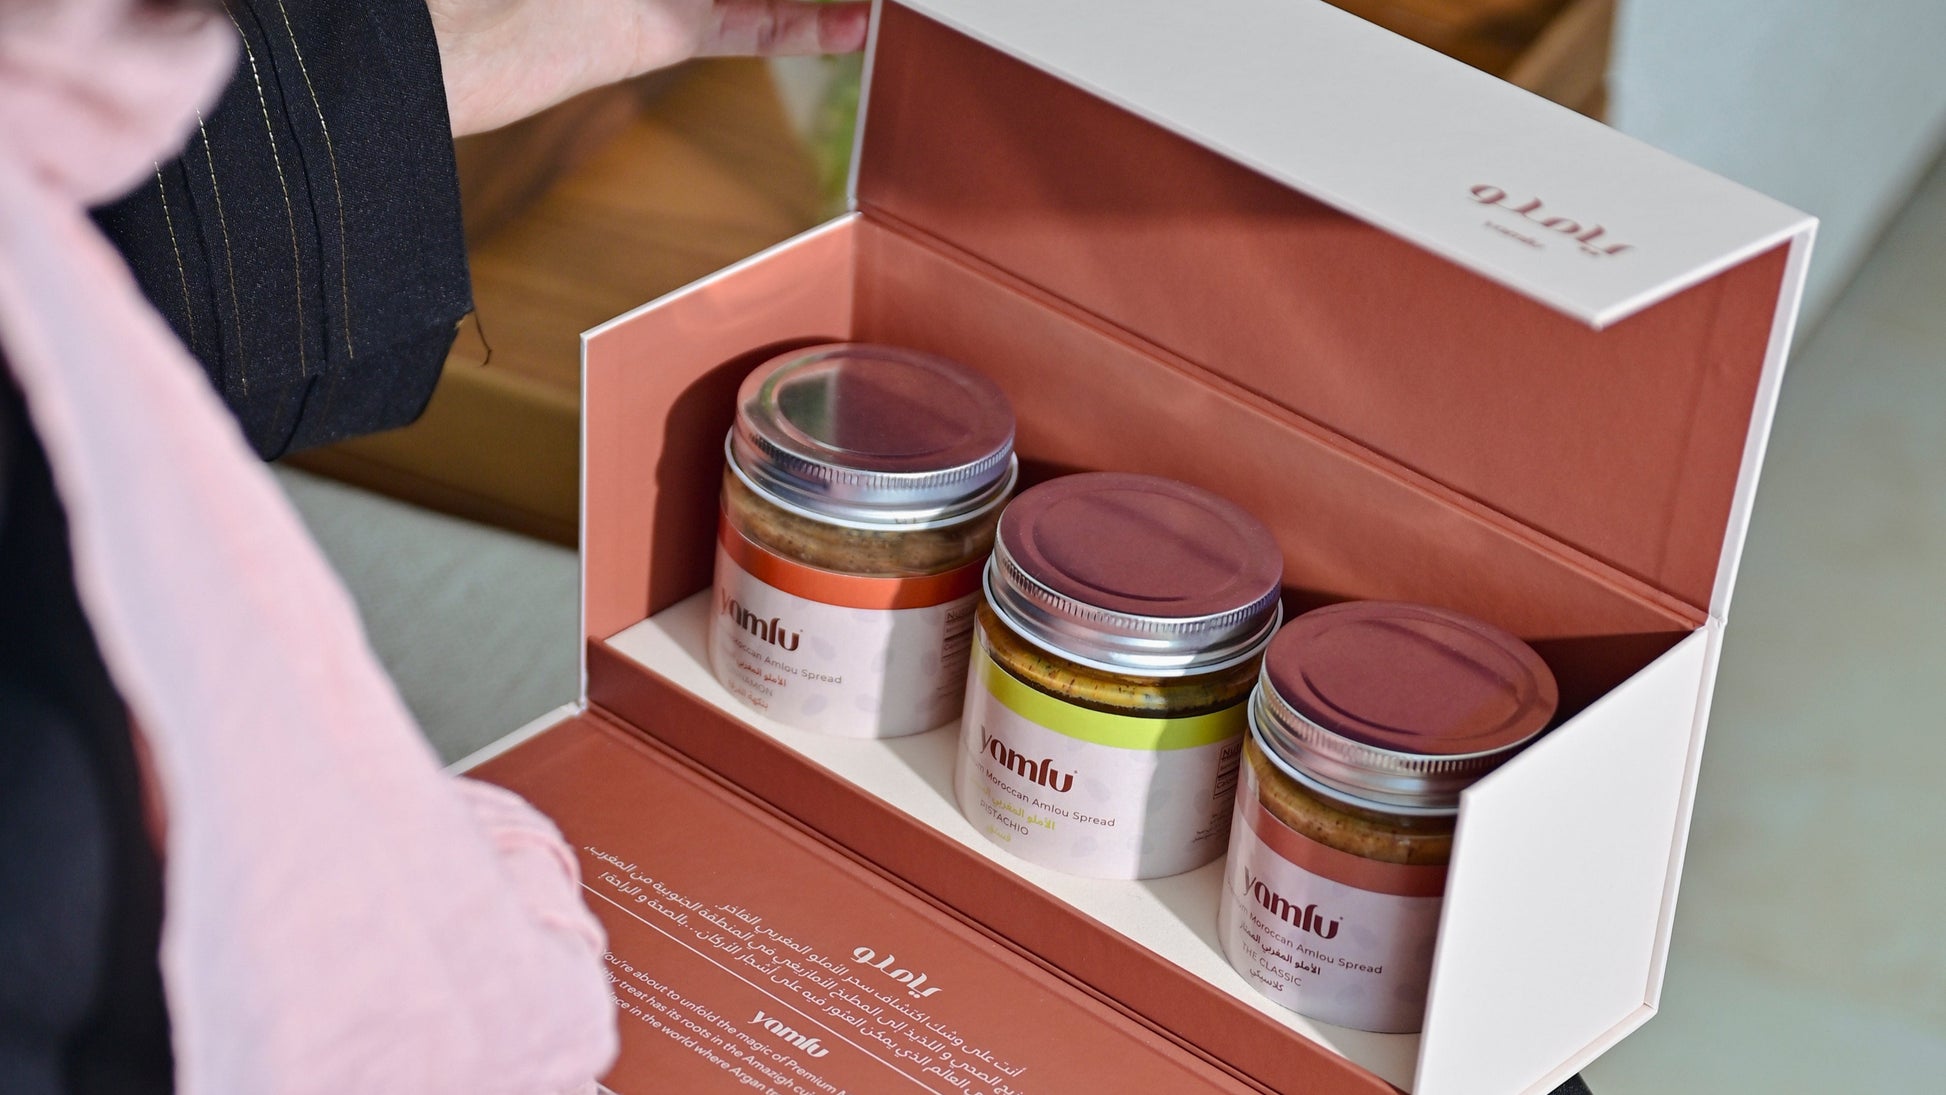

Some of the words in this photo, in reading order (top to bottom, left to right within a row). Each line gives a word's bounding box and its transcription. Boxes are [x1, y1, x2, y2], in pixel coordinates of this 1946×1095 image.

[721, 587, 800, 651] yamlu
[763, 656, 798, 675] Amlou
[801, 668, 842, 684] Spread
[980, 725, 1075, 793] yamlu
[985, 768, 1029, 803] Moroccan
[1032, 798, 1069, 818] Amlou
[1072, 812, 1116, 828] Spread
[980, 799, 1029, 836] PISTACHIO
[629, 871, 653, 885] من
[652, 882, 701, 912] الجنوبية
[1243, 865, 1340, 940] yamlu
[698, 906, 755, 941] المنطقة
[747, 940, 776, 956] في
[755, 924, 813, 955] المغربي
[1249, 912, 1294, 948] Moroccan
[1296, 944, 1334, 964] Amlou
[1338, 957, 1383, 975] Spread
[1261, 944, 1293, 963] المغربي
[734, 953, 782, 976] أشجار
[772, 954, 838, 990] الأمازيغي
[806, 952, 850, 976] الأملو
[850, 946, 943, 999] ياملو
[1242, 942, 1258, 961] THE
[1259, 958, 1302, 986] CLASSIC
[770, 973, 803, 992] على
[841, 975, 875, 994] سحر
[802, 990, 825, 1006] فيه
[829, 988, 884, 1017] المطبخ
[874, 992, 931, 1024] اكتشاف
[822, 1005, 868, 1028] العثور
[876, 1015, 908, 1033] إلى
[619, 980, 649, 1000] treat
[646, 995, 668, 1012] has
[666, 1008, 682, 1022] its
[680, 1018, 712, 1039] roots
[710, 1034, 724, 1046] in
[722, 1042, 744, 1058] the
[741, 1054, 794, 1088] Amazigh
[632, 972, 668, 993] about
[666, 989, 680, 1000] to
[680, 998, 721, 1023] unfold
[716, 1019, 737, 1034] the
[736, 1031, 773, 1056] magic
[771, 1053, 791, 1064] of
[784, 1059, 837, 1094] Premium
[747, 1010, 830, 1058] yamlu
[860, 1026, 898, 1049] يمكن
[904, 1028, 946, 1053] اللذيذ
[925, 1022, 964, 1047] وشك
[628, 1005, 642, 1017] in
[641, 1012, 662, 1028] the
[661, 1025, 698, 1048] world
[693, 1044, 731, 1070] where
[728, 1067, 766, 1092] Argan
[895, 1047, 933, 1066] الذي
[939, 1051, 952, 1061] و
[961, 1045, 995, 1063] على
[922, 1065, 971, 1088] العالم
[949, 1058, 1003, 1086] الصحي
[993, 1061, 1028, 1077] أنت
